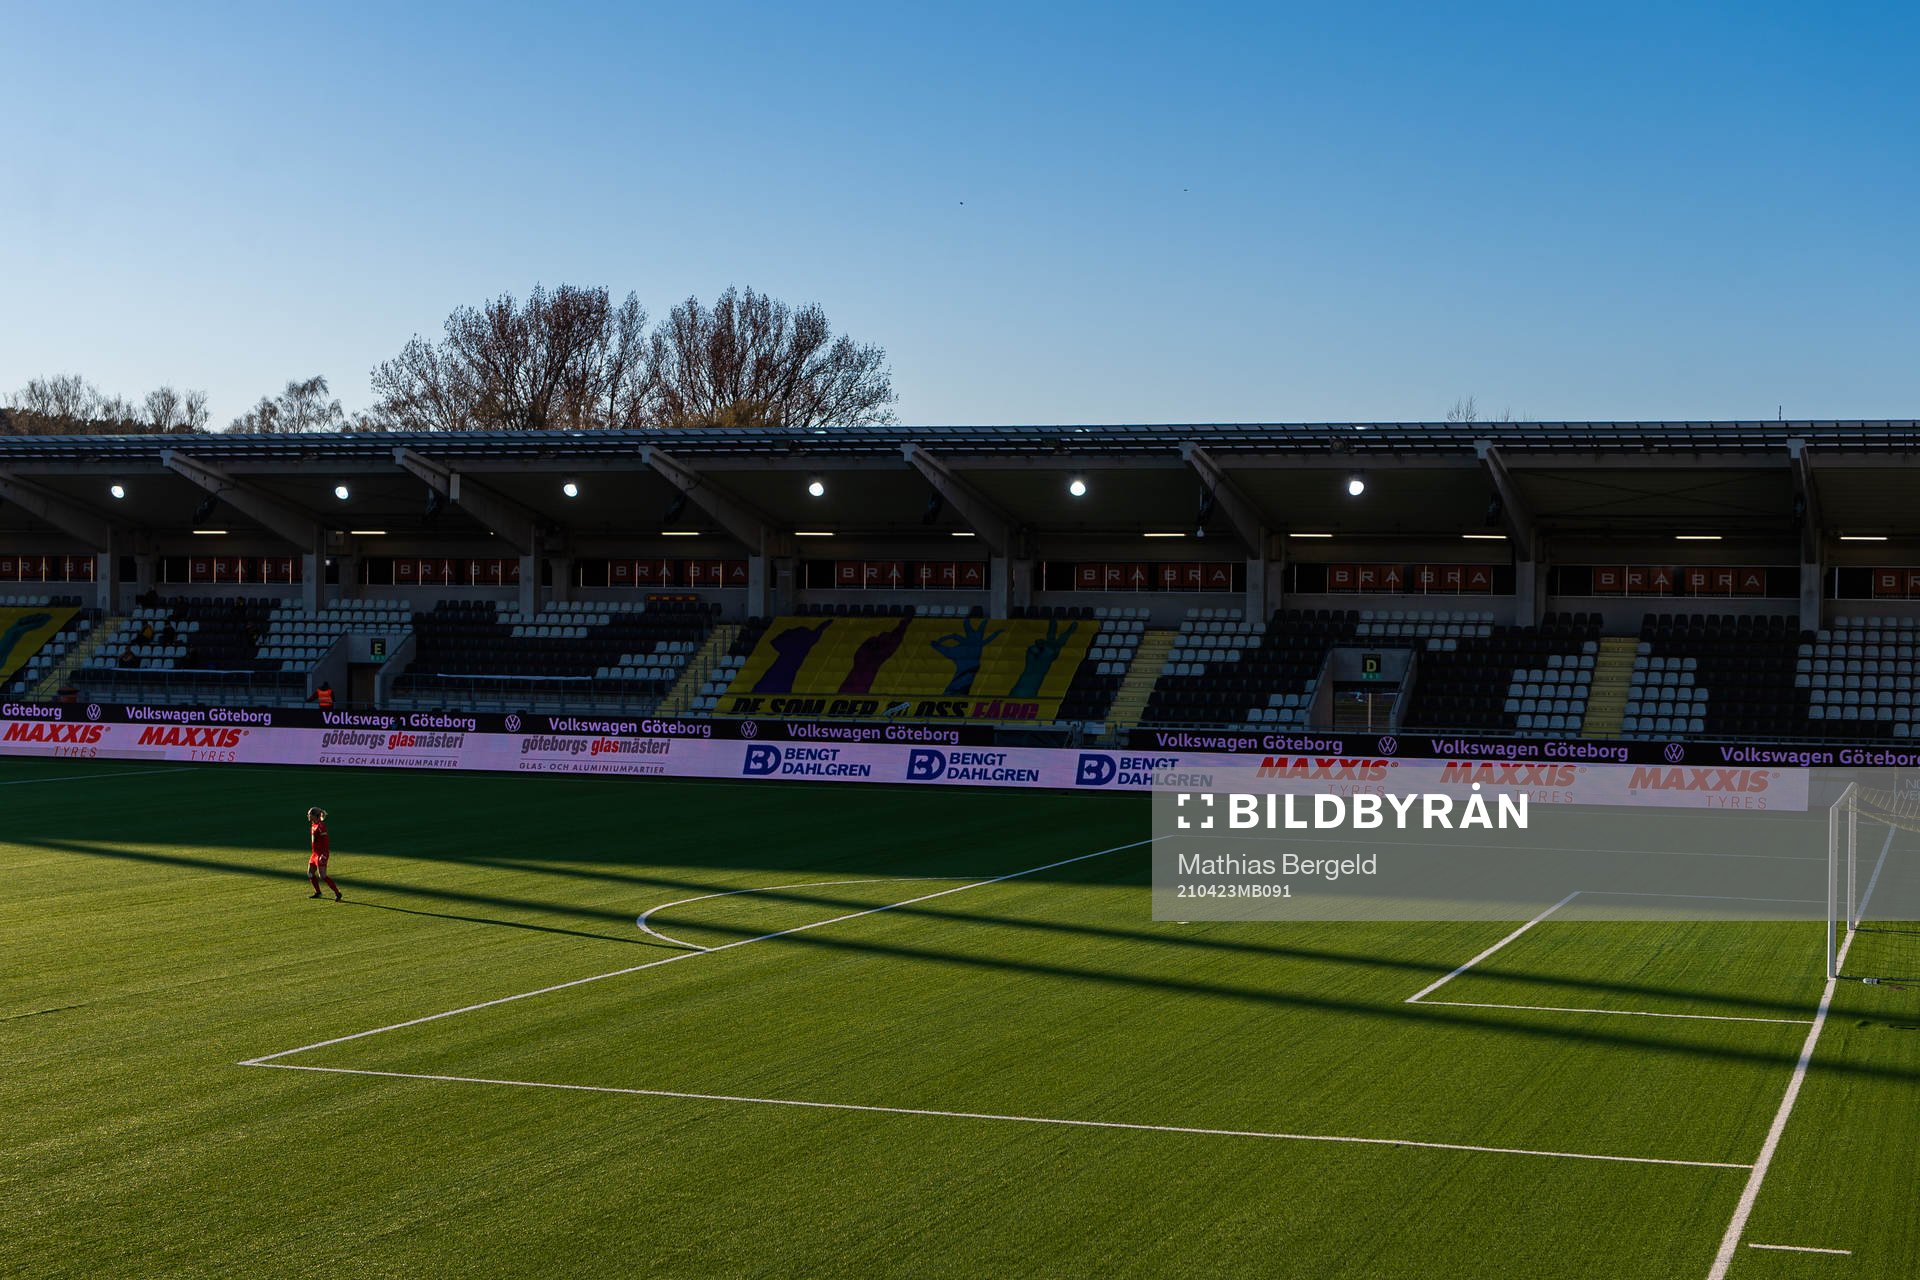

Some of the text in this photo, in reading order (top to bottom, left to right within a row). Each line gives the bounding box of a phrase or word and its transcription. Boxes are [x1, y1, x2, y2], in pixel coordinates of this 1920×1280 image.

[261, 564, 303, 575] BR
[374, 643, 382, 654] E
[1366, 659, 1376, 672] D
[2, 704, 62, 719] Göteborg
[126, 706, 272, 725] Volkswagen Göteborg
[410, 713, 476, 732] Göteborg
[549, 717, 711, 737] Volkswagen Göteborg
[322, 730, 464, 750] göteborgs glasmästeri
[787, 723, 959, 745] Volkswagen Göteborg
[521, 735, 671, 756] göteborgs glasmästeri
[1156, 733, 1343, 755] Volkswagen Göteborg
[1431, 739, 1629, 762] Volkswagen Göteborg
[54, 746, 97, 759] TYRES
[191, 750, 236, 762] TYRES
[784, 747, 840, 762] BENGT
[950, 752, 1007, 766] BENGT
[1720, 746, 1833, 767] Volkswagen
[348, 757, 367, 765] OCH
[370, 757, 458, 768] ALUMINIUMPARTIER
[550, 763, 569, 771] OCH
[572, 764, 664, 774] ALUMINIUMPARTIER
[781, 762, 871, 777] DAHLGREN
[1119, 757, 1179, 770] BENGT
[946, 767, 1039, 782] DAHLGREN
[1117, 772, 1213, 788] DAHLGREN
[1706, 795, 1767, 809] TYRES
